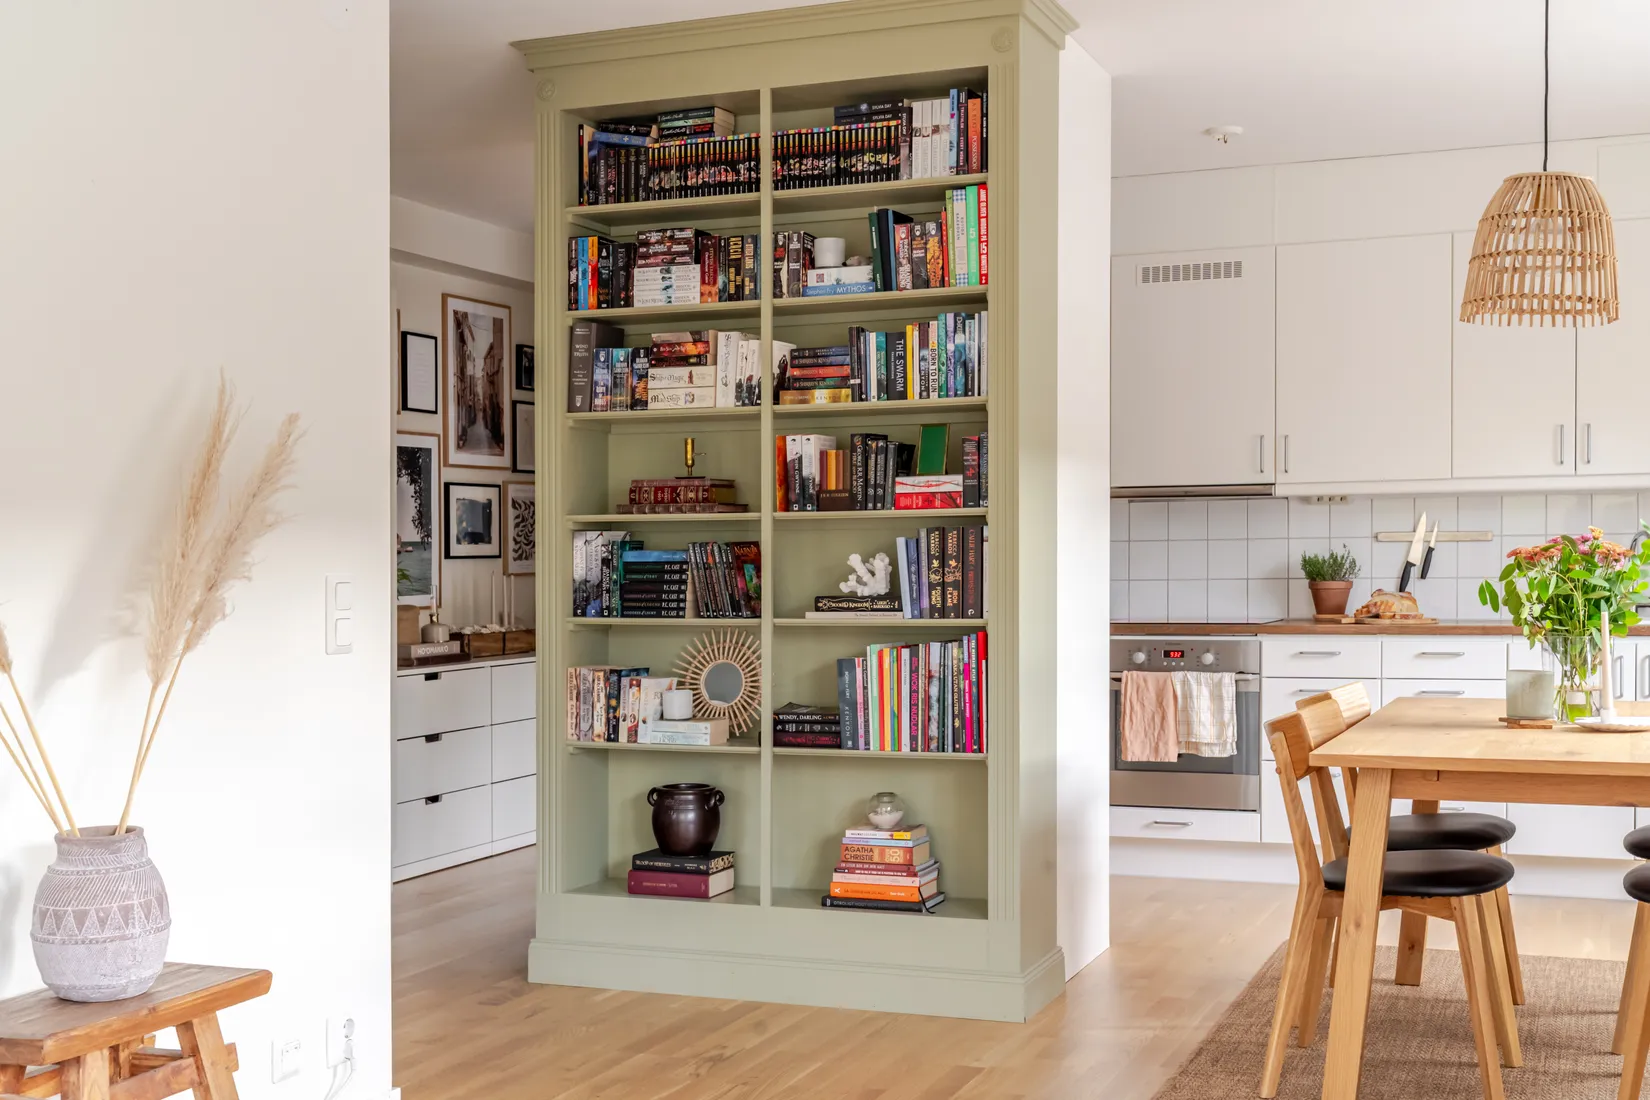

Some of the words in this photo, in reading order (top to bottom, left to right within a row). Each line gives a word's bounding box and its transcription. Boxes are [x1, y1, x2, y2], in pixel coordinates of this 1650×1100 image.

[729, 237, 741, 259] ACACIA
[896, 339, 904, 356] THE
[896, 360, 904, 391] SWARM
[931, 367, 936, 376] TO
